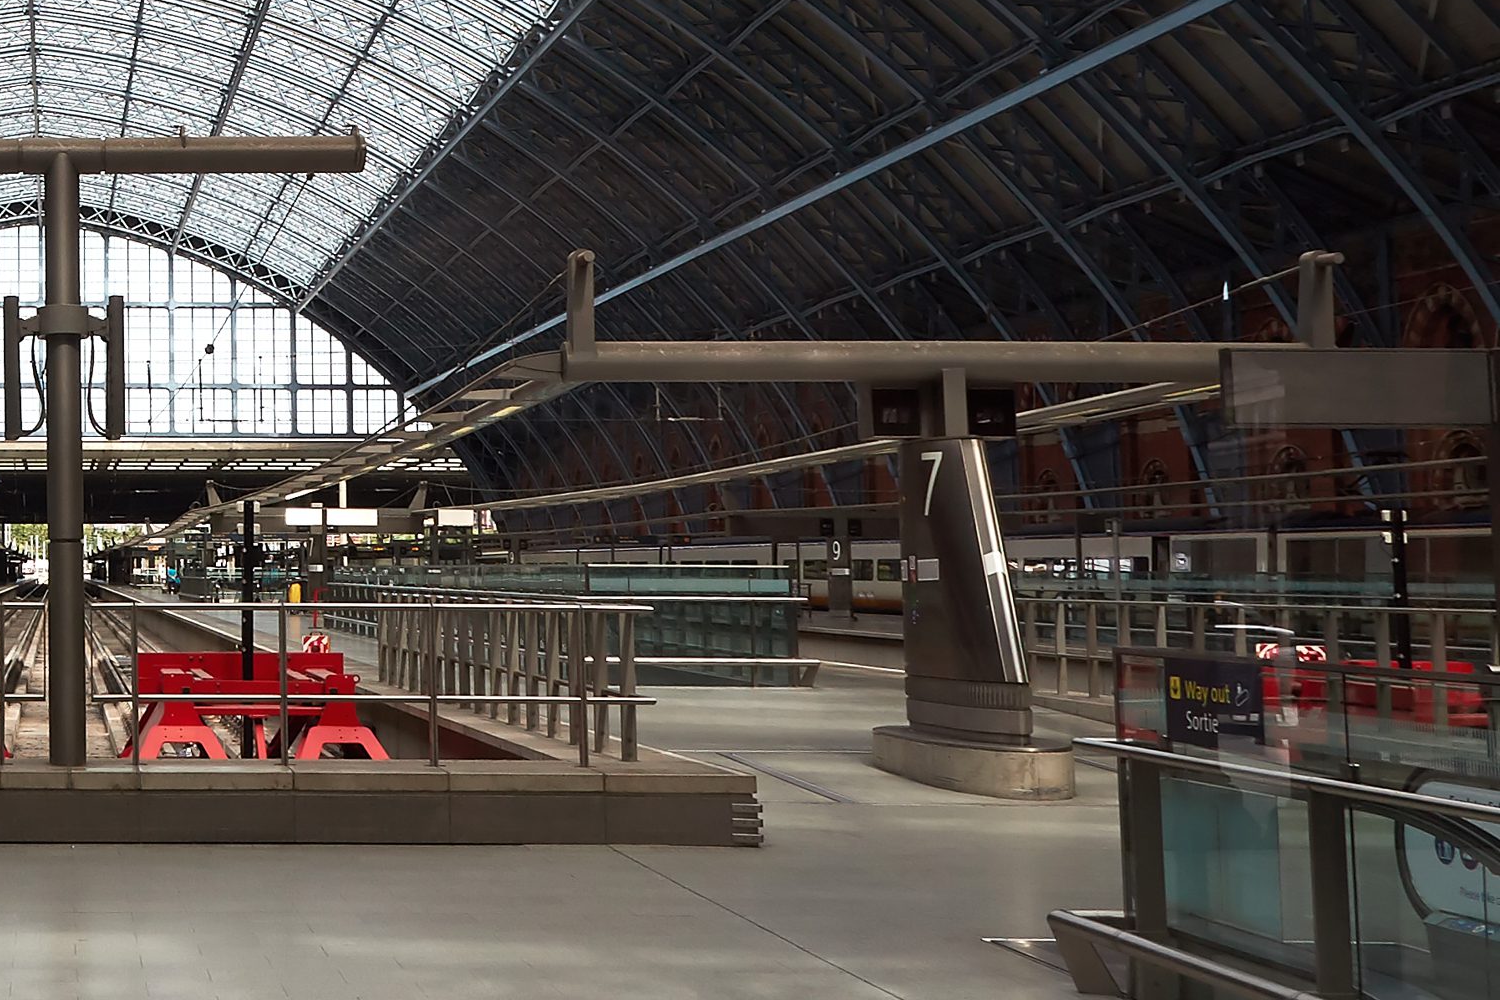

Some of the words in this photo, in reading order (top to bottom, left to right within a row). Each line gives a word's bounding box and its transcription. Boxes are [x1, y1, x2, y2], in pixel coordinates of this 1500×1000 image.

[921, 452, 943, 516] 7
[308, 537, 314, 557] 7
[833, 541, 841, 560] 9
[1184, 680, 1209, 707] Way
[1210, 684, 1231, 704] out
[1185, 710, 1219, 733] Sortie
